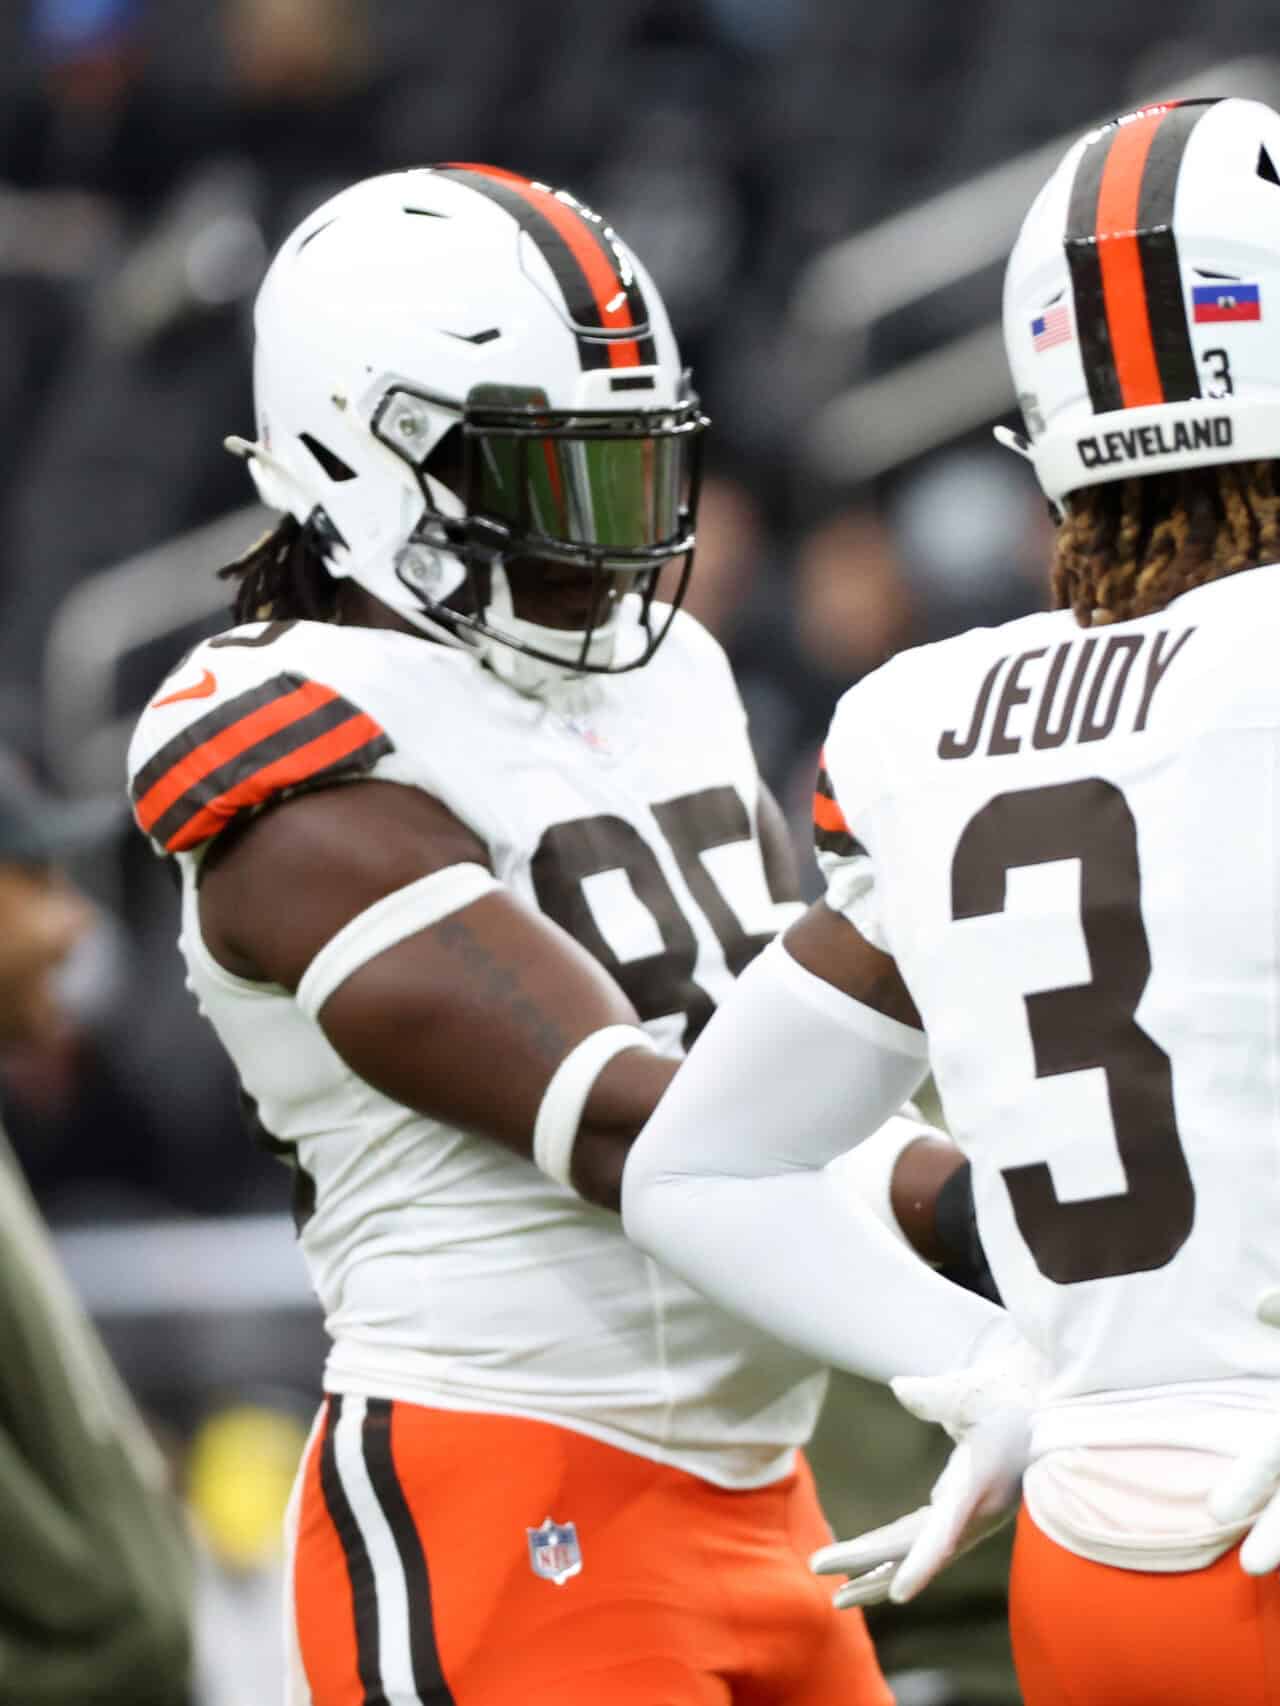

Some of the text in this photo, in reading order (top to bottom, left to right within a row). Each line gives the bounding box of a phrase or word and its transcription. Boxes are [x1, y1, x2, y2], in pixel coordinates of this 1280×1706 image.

[1202, 348, 1233, 398] 3
[1077, 416, 1232, 469] CLEVELAND
[937, 626, 1197, 760] JEUDY
[951, 777, 1196, 1285] 3
